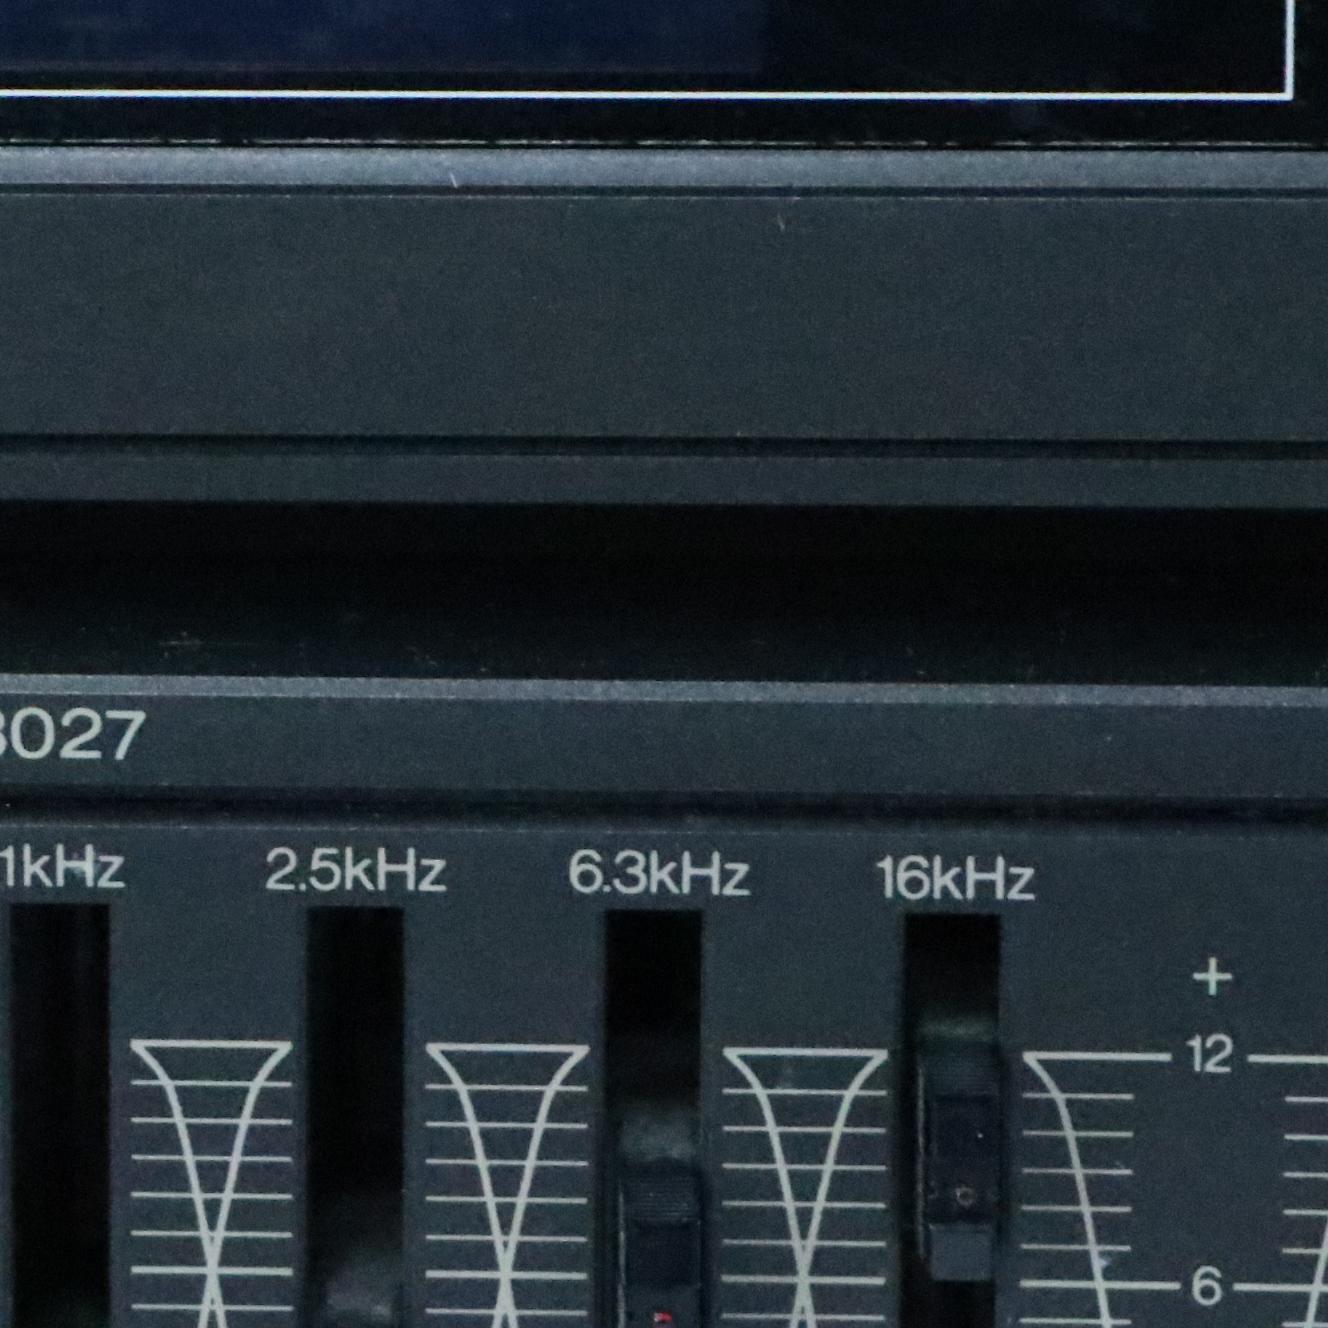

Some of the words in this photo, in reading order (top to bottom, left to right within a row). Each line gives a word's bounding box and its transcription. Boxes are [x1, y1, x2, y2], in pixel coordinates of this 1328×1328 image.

[0, 843, 126, 889] 1kHz
[265, 846, 447, 892] 2.5kHz
[569, 848, 751, 896] 6.3kHz
[876, 854, 1036, 901] 16kHz
[1187, 1033, 1233, 1074] 12
[1191, 1265, 1223, 1306] 6
